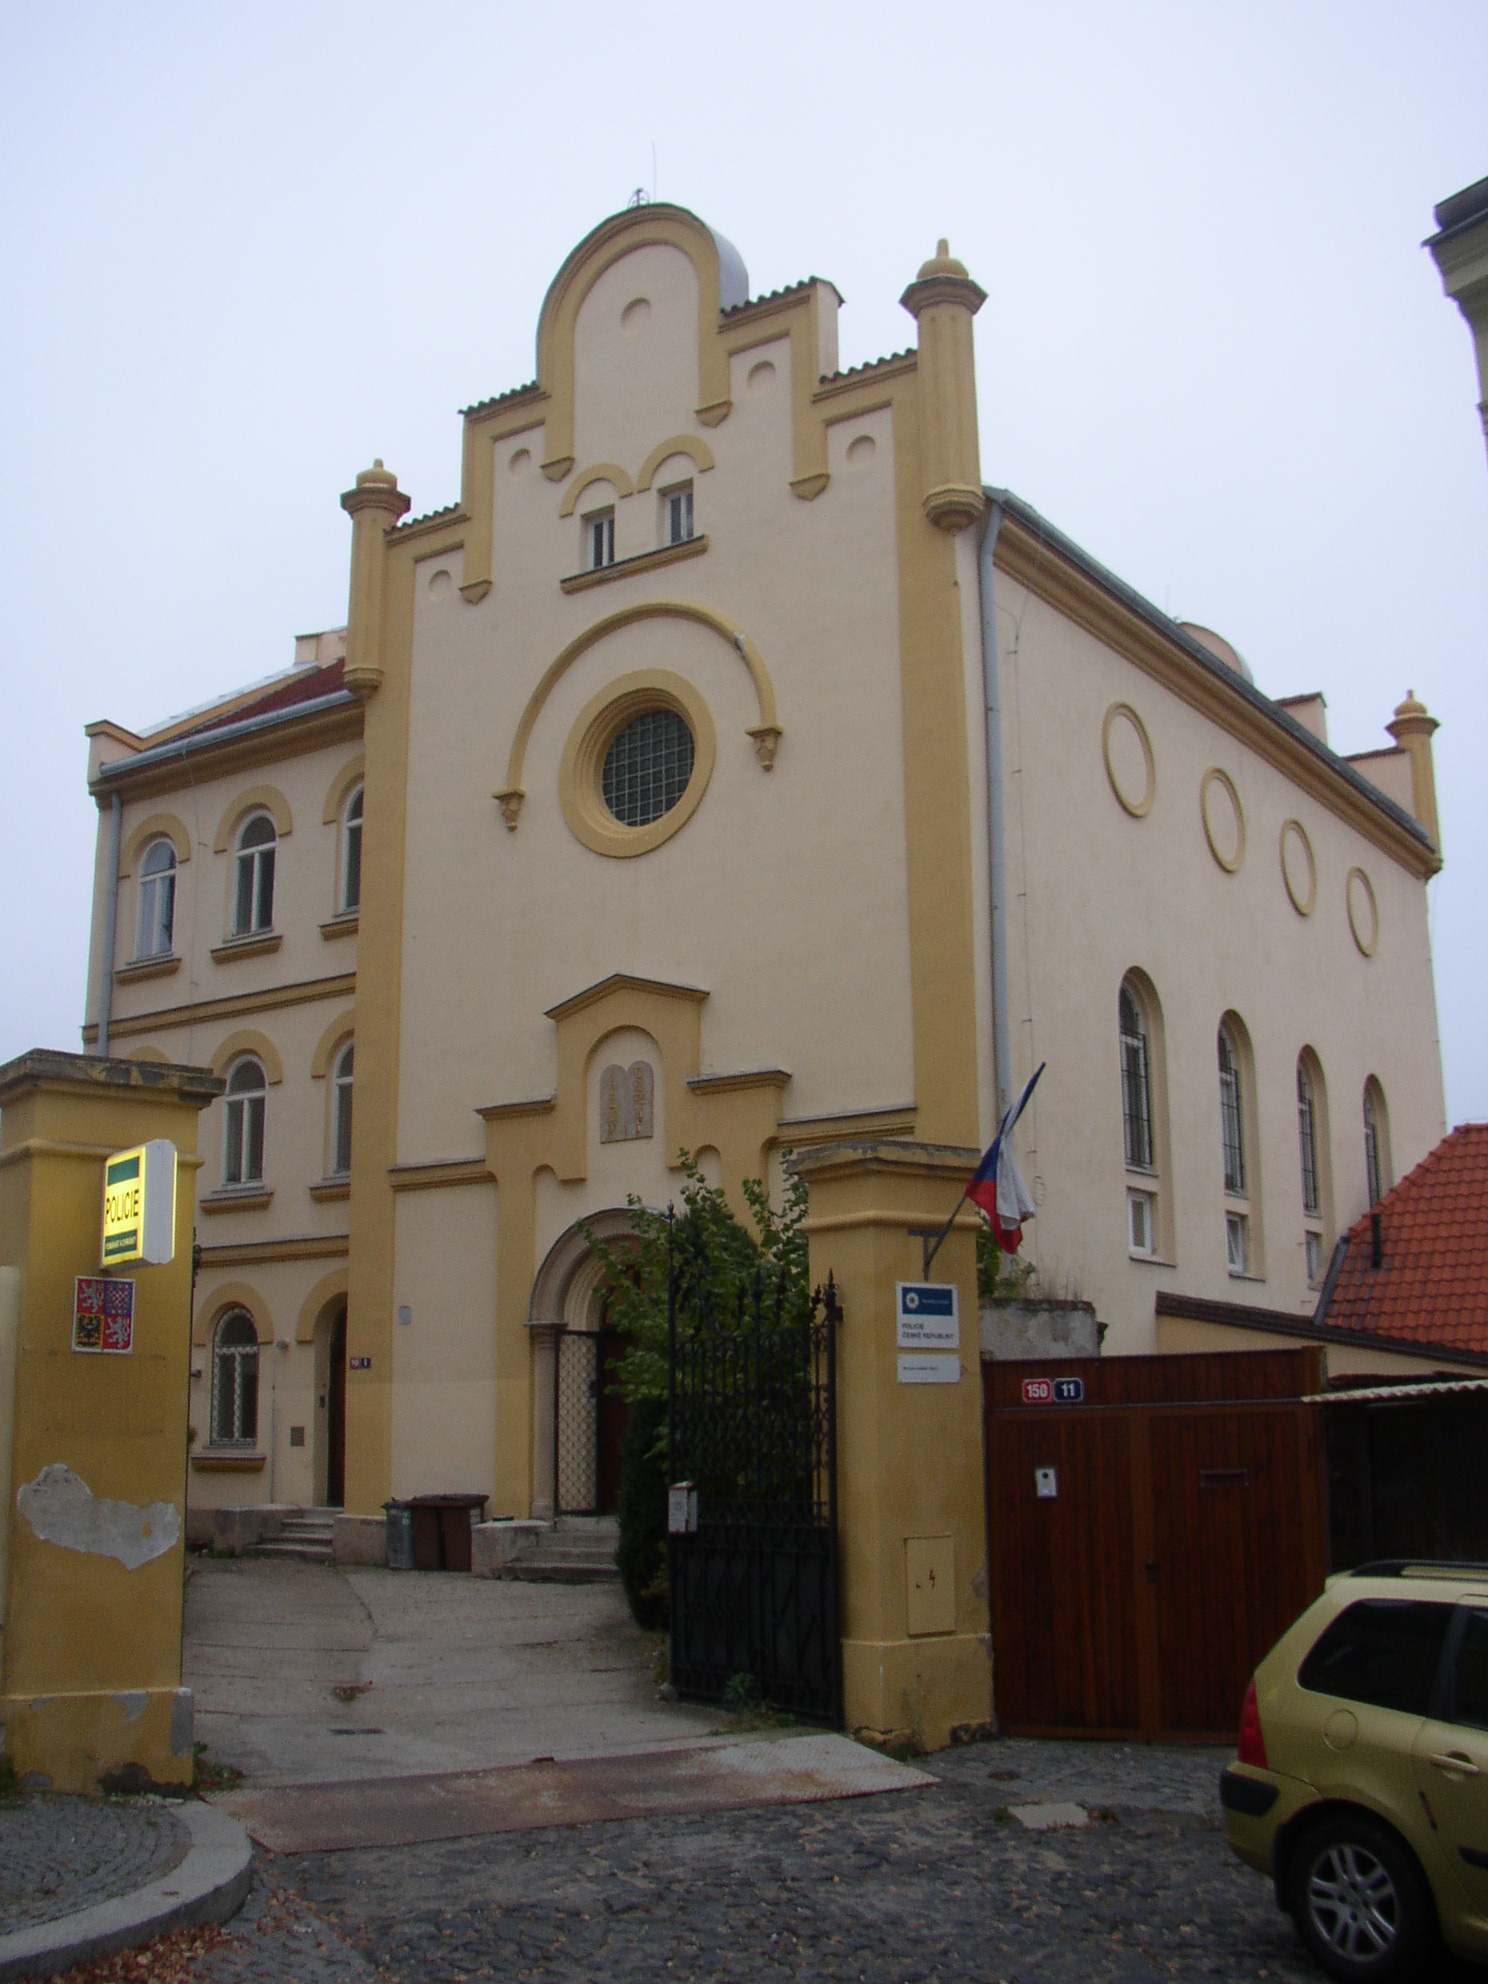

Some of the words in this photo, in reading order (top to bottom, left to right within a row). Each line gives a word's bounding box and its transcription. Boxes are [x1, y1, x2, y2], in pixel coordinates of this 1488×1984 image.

[104, 1188, 139, 1225] POLICIE
[1026, 1383, 1048, 1398] 150
[1061, 1382, 1075, 1397] 11
